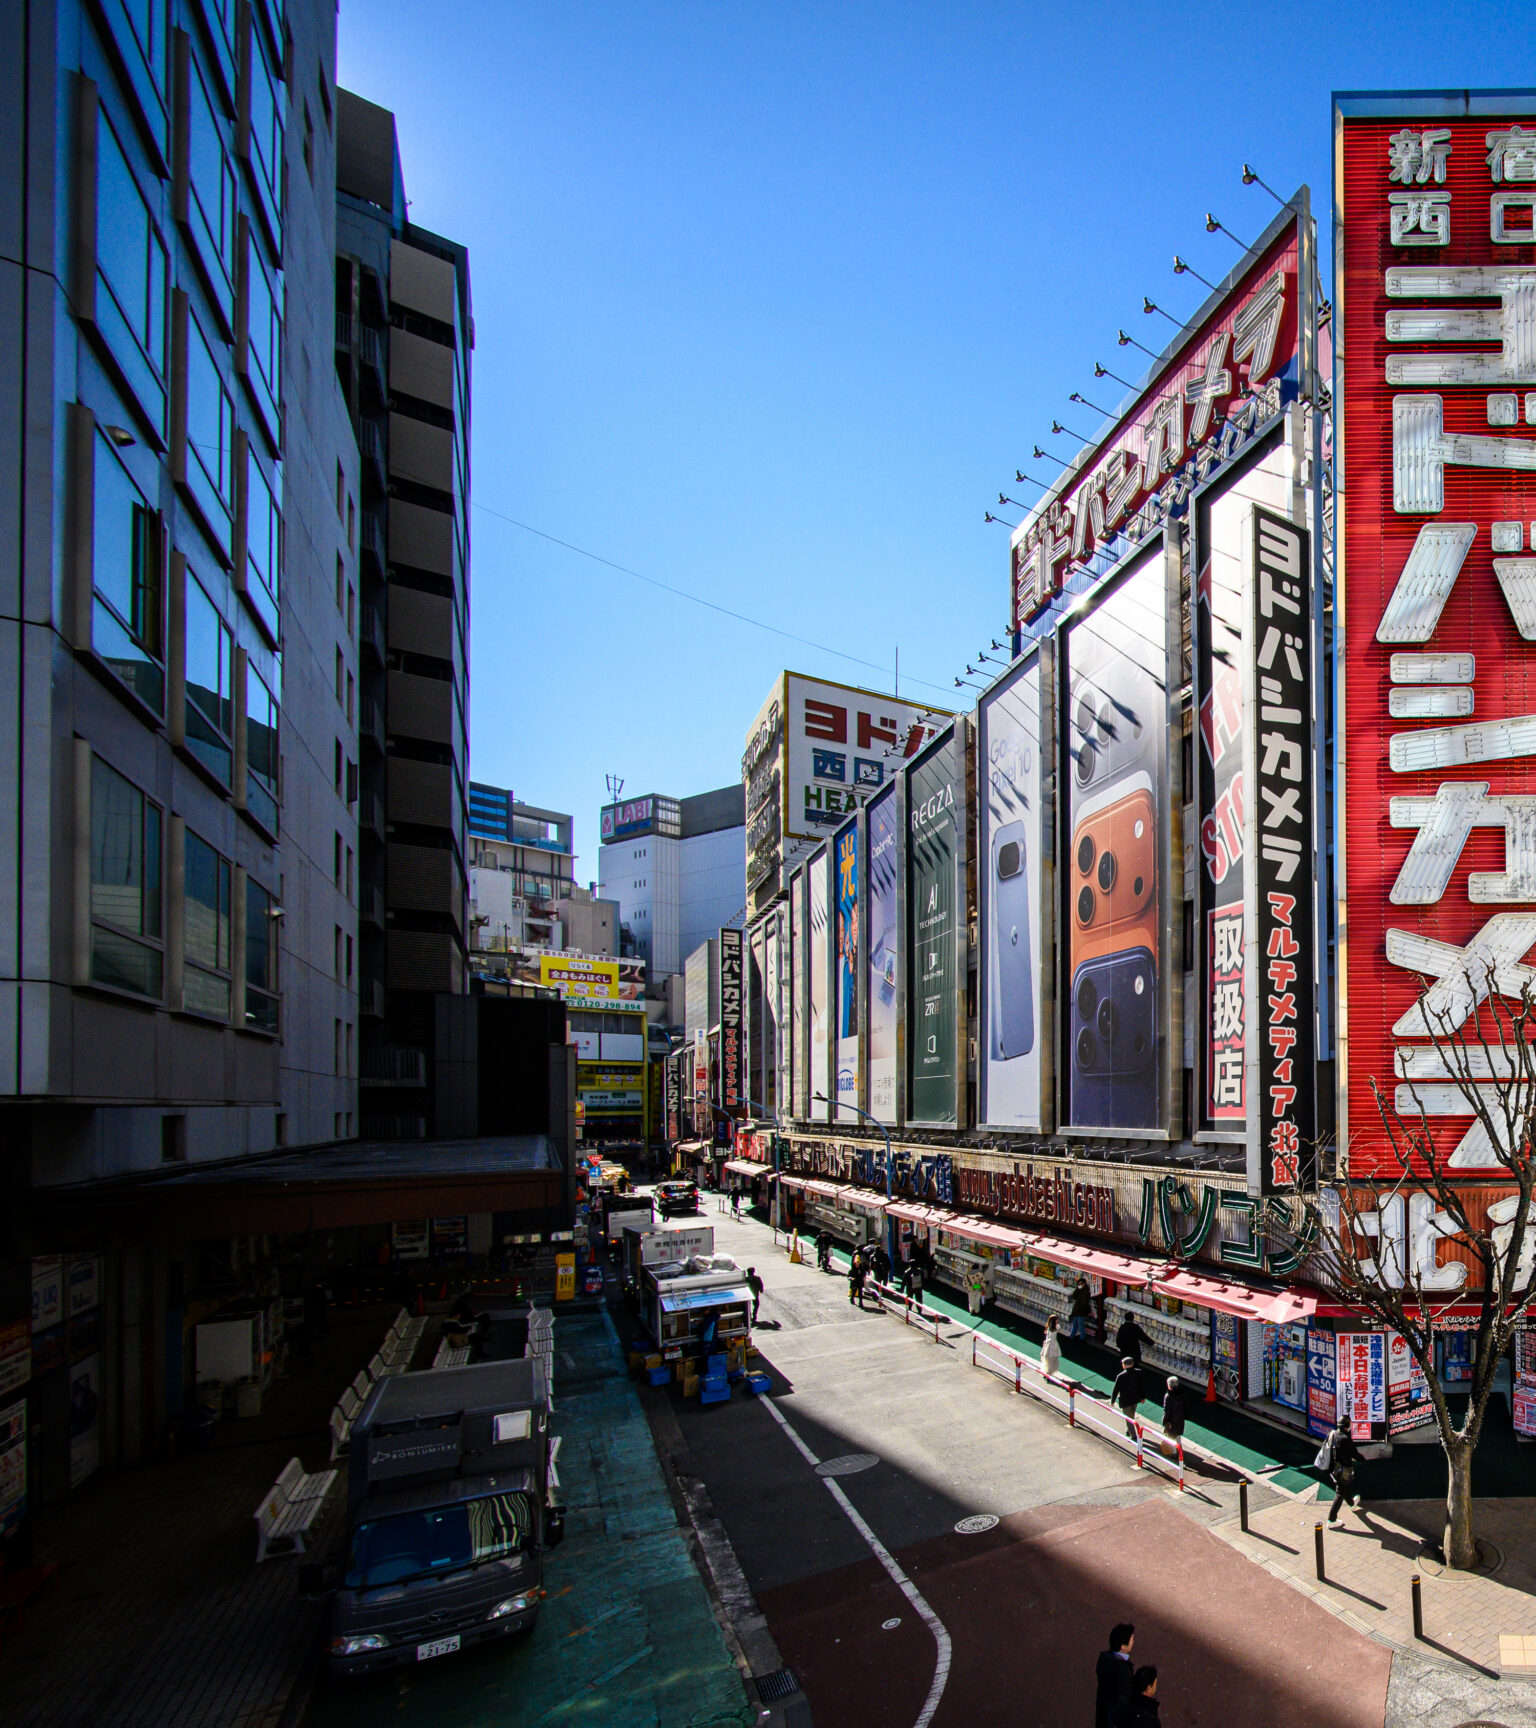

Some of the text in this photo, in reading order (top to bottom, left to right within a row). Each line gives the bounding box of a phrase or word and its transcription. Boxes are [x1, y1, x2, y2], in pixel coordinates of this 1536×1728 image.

[1017, 268, 1286, 624] ヨドバシカメラ
[1019, 747, 1032, 777] 10
[615, 799, 650, 826] LABI
[804, 785, 867, 813] HEA
[911, 784, 954, 831] REGZA
[839, 834, 858, 903] 光
[1257, 517, 1304, 1187] ヨドバシカメラ マルチメディア北館
[919, 911, 948, 931] TECHNOLOGY
[927, 884, 939, 914] AI
[550, 970, 610, 983] 全身もみほぐし
[594, 989, 610, 997] No.1
[722, 932, 741, 1026] ヨドバシカメラ
[577, 1000, 641, 1011] 0120-298-894
[1212, 914, 1245, 1108] 取扱店
[667, 1057, 679, 1113] ヨドバシカメラ
[959, 1162, 1119, 1233] www.yodobashi.com
[1137, 1174, 1321, 1277] パソコン
[1308, 1339, 1334, 1358] 駐車場
[1352, 1344, 1369, 1421] 本日お届け・設置
[1370, 1334, 1383, 1413] 冷蔵庫・洗濯機・テレビ
[427, 1641, 457, 1657] 21-75
